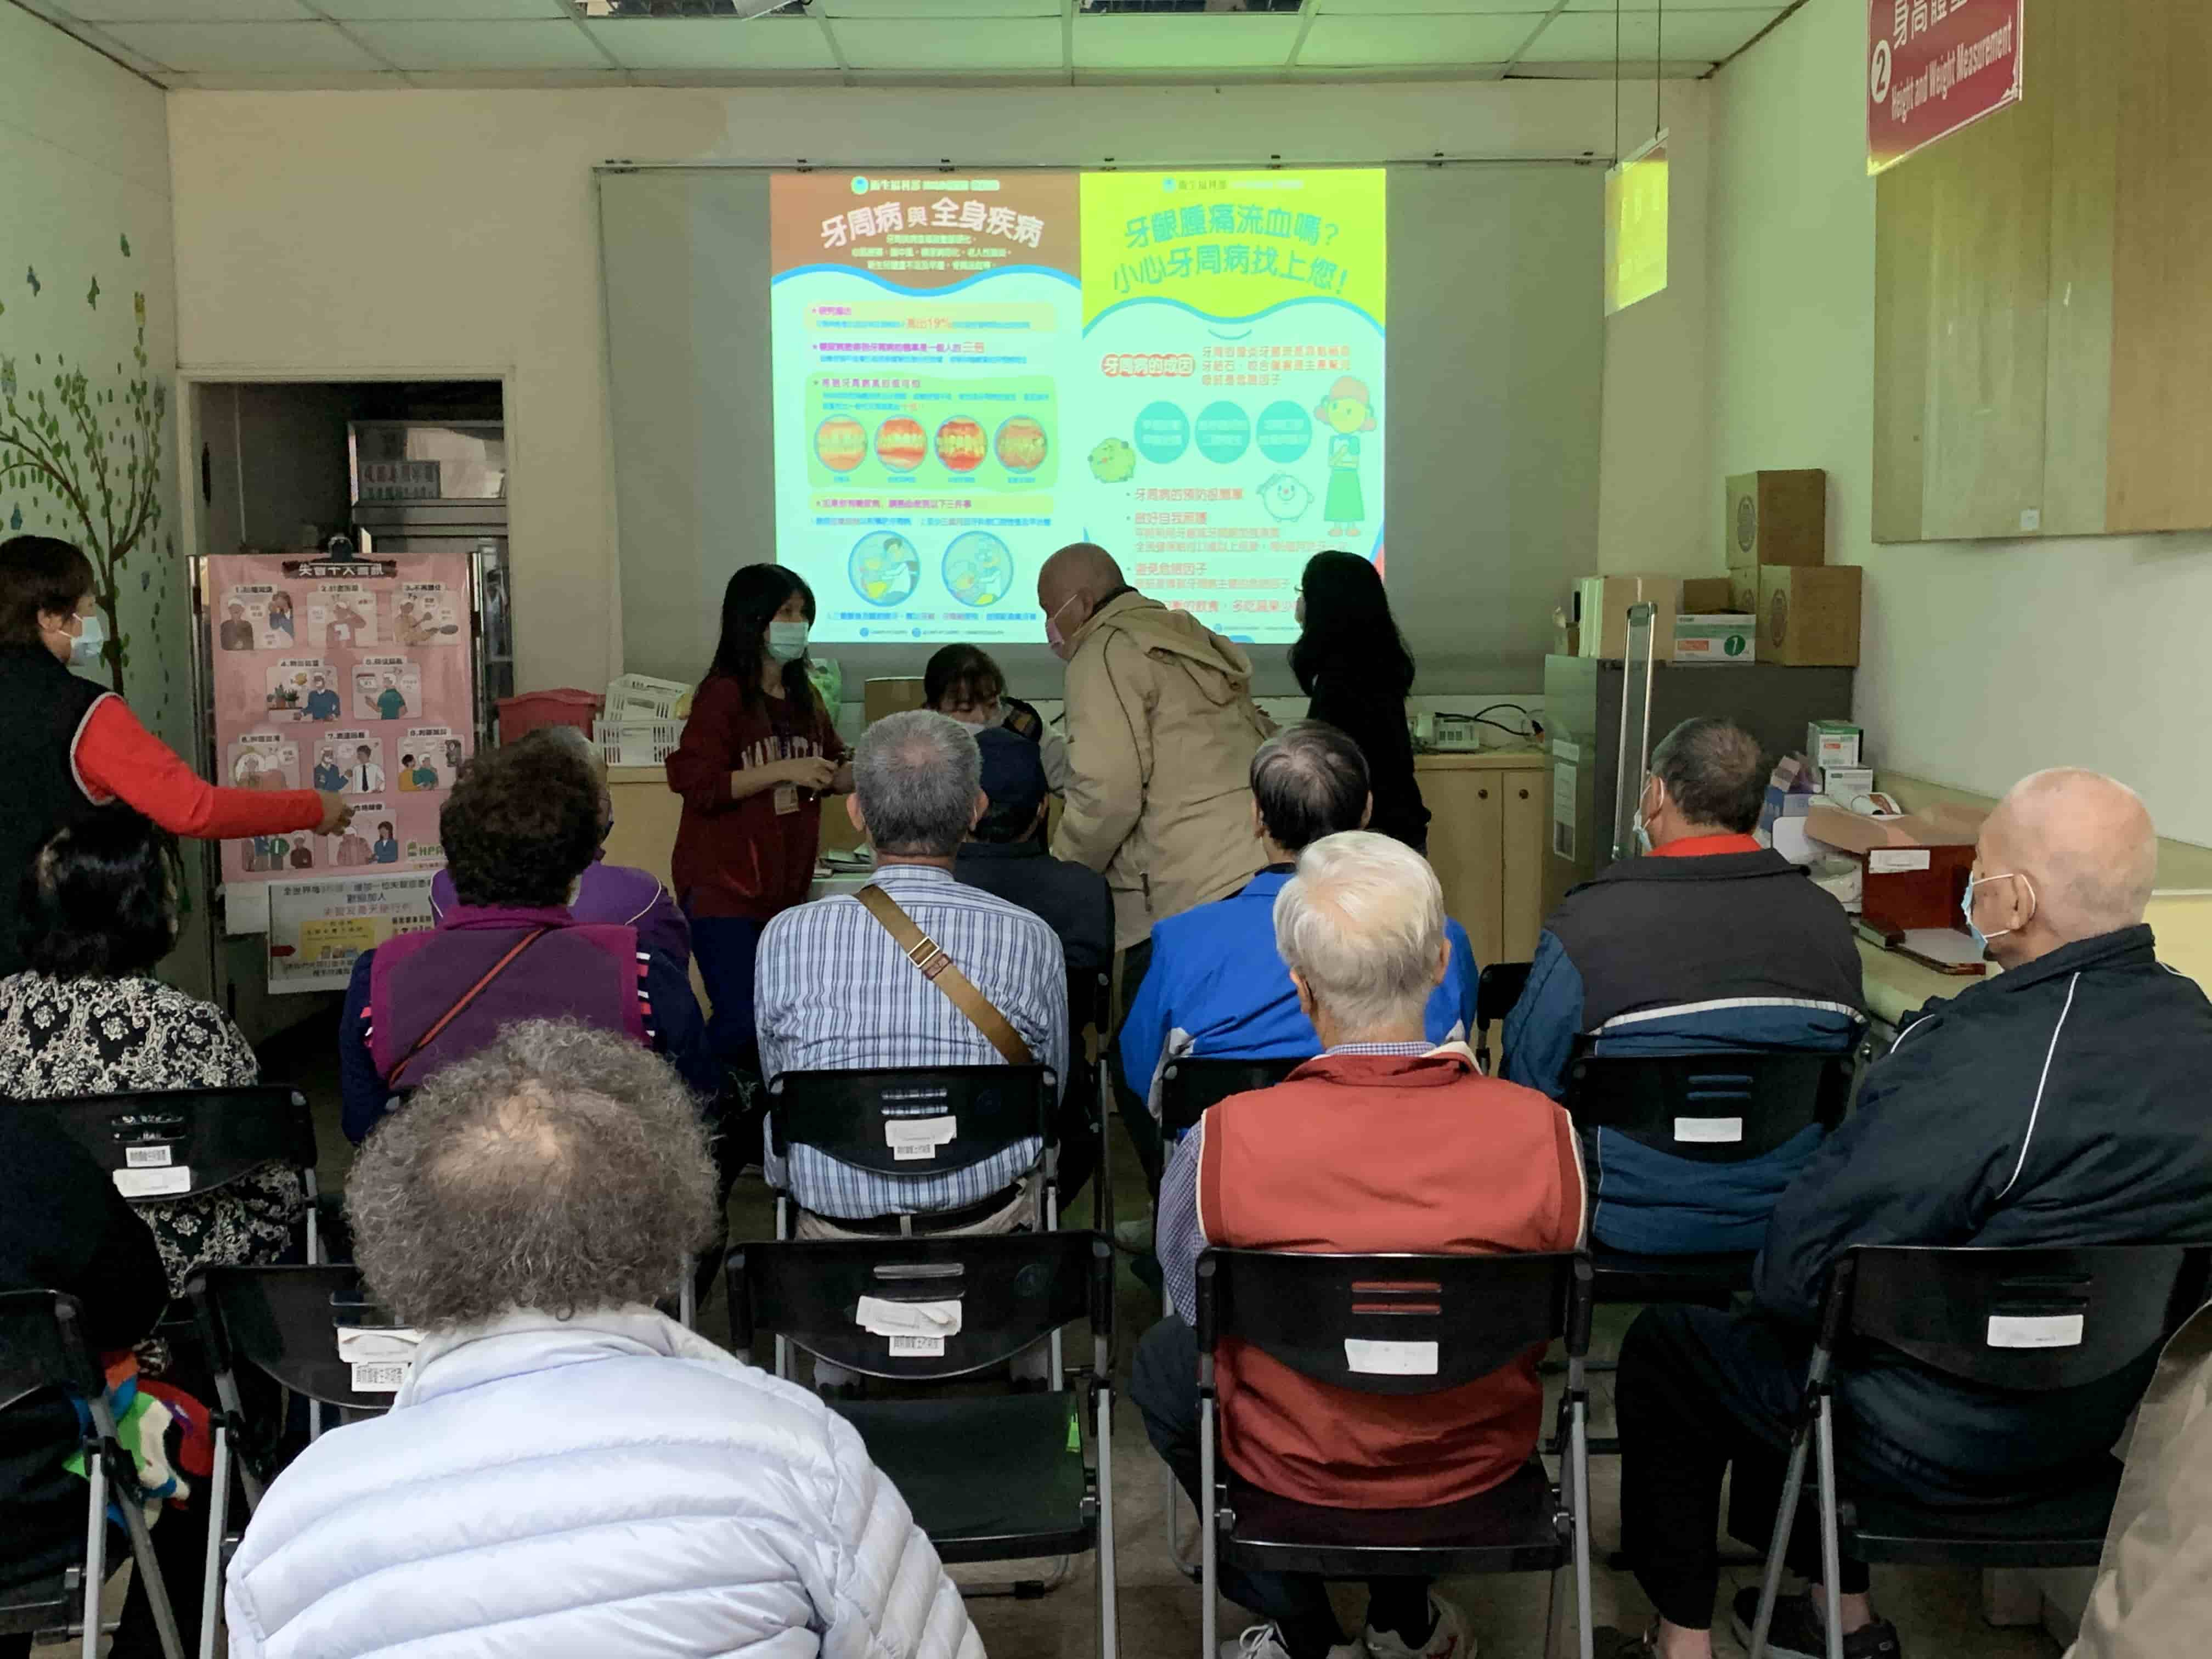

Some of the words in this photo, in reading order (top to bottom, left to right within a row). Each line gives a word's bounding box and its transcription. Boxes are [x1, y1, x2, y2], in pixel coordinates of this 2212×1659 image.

[1915, 65, 1927, 106] and
[1929, 50, 1955, 100] Weight
[1956, 15, 2011, 83] Measurement
